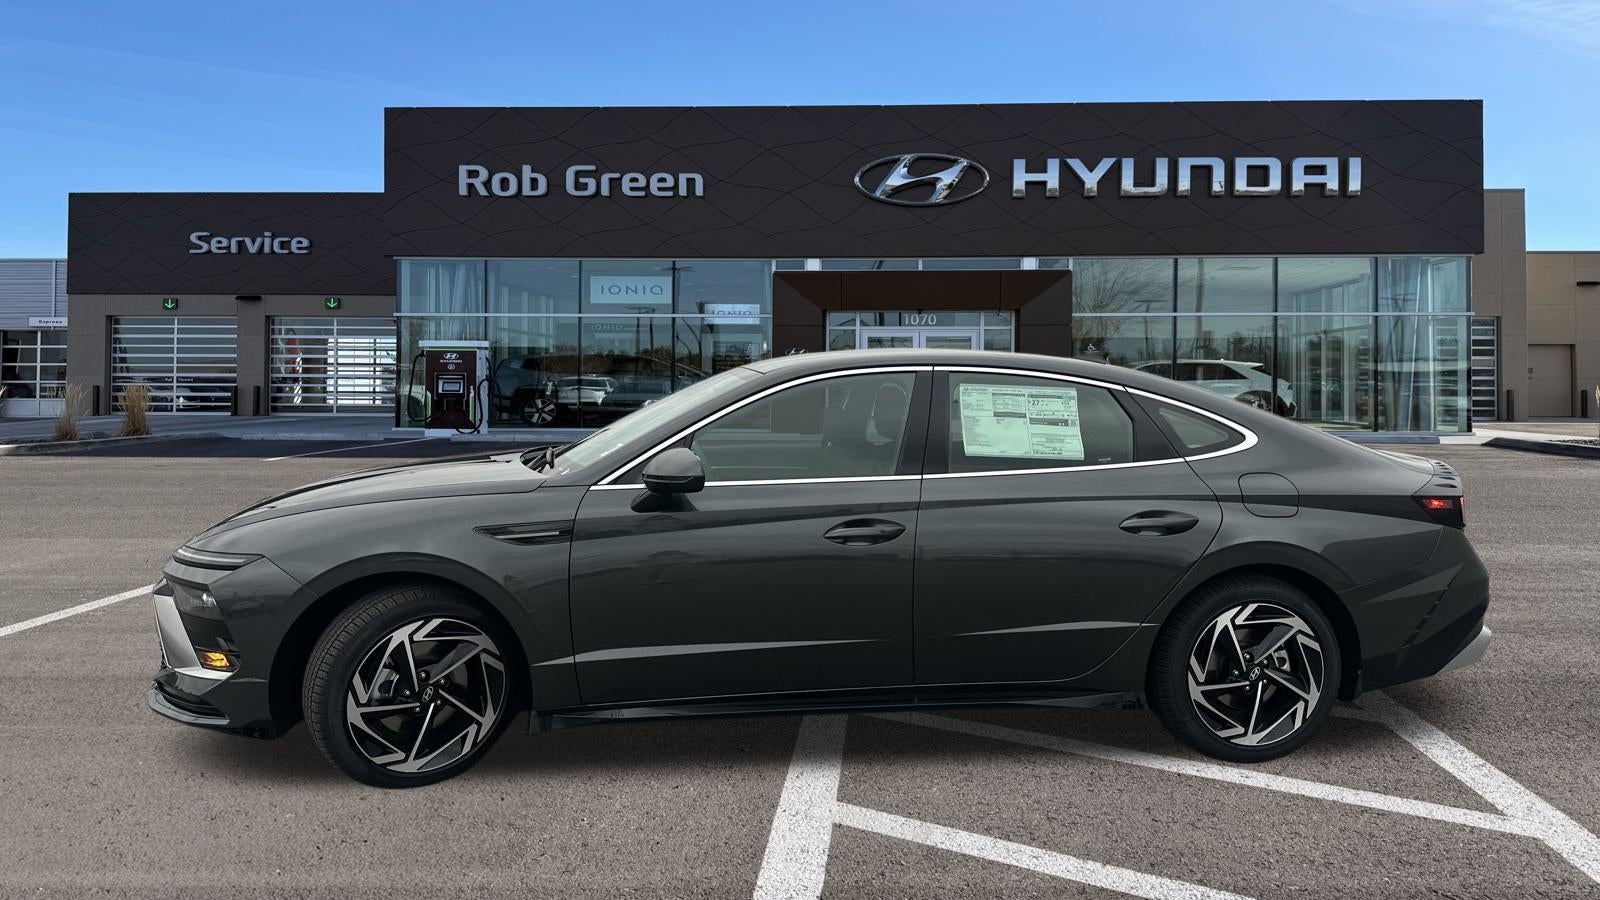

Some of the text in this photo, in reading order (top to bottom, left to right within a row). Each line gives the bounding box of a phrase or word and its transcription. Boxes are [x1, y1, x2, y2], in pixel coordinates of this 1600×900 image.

[458, 164, 704, 197] Rob Green
[1012, 157, 1362, 197] HYUNDAI
[189, 231, 310, 254] Service
[904, 314, 937, 325] 1070
